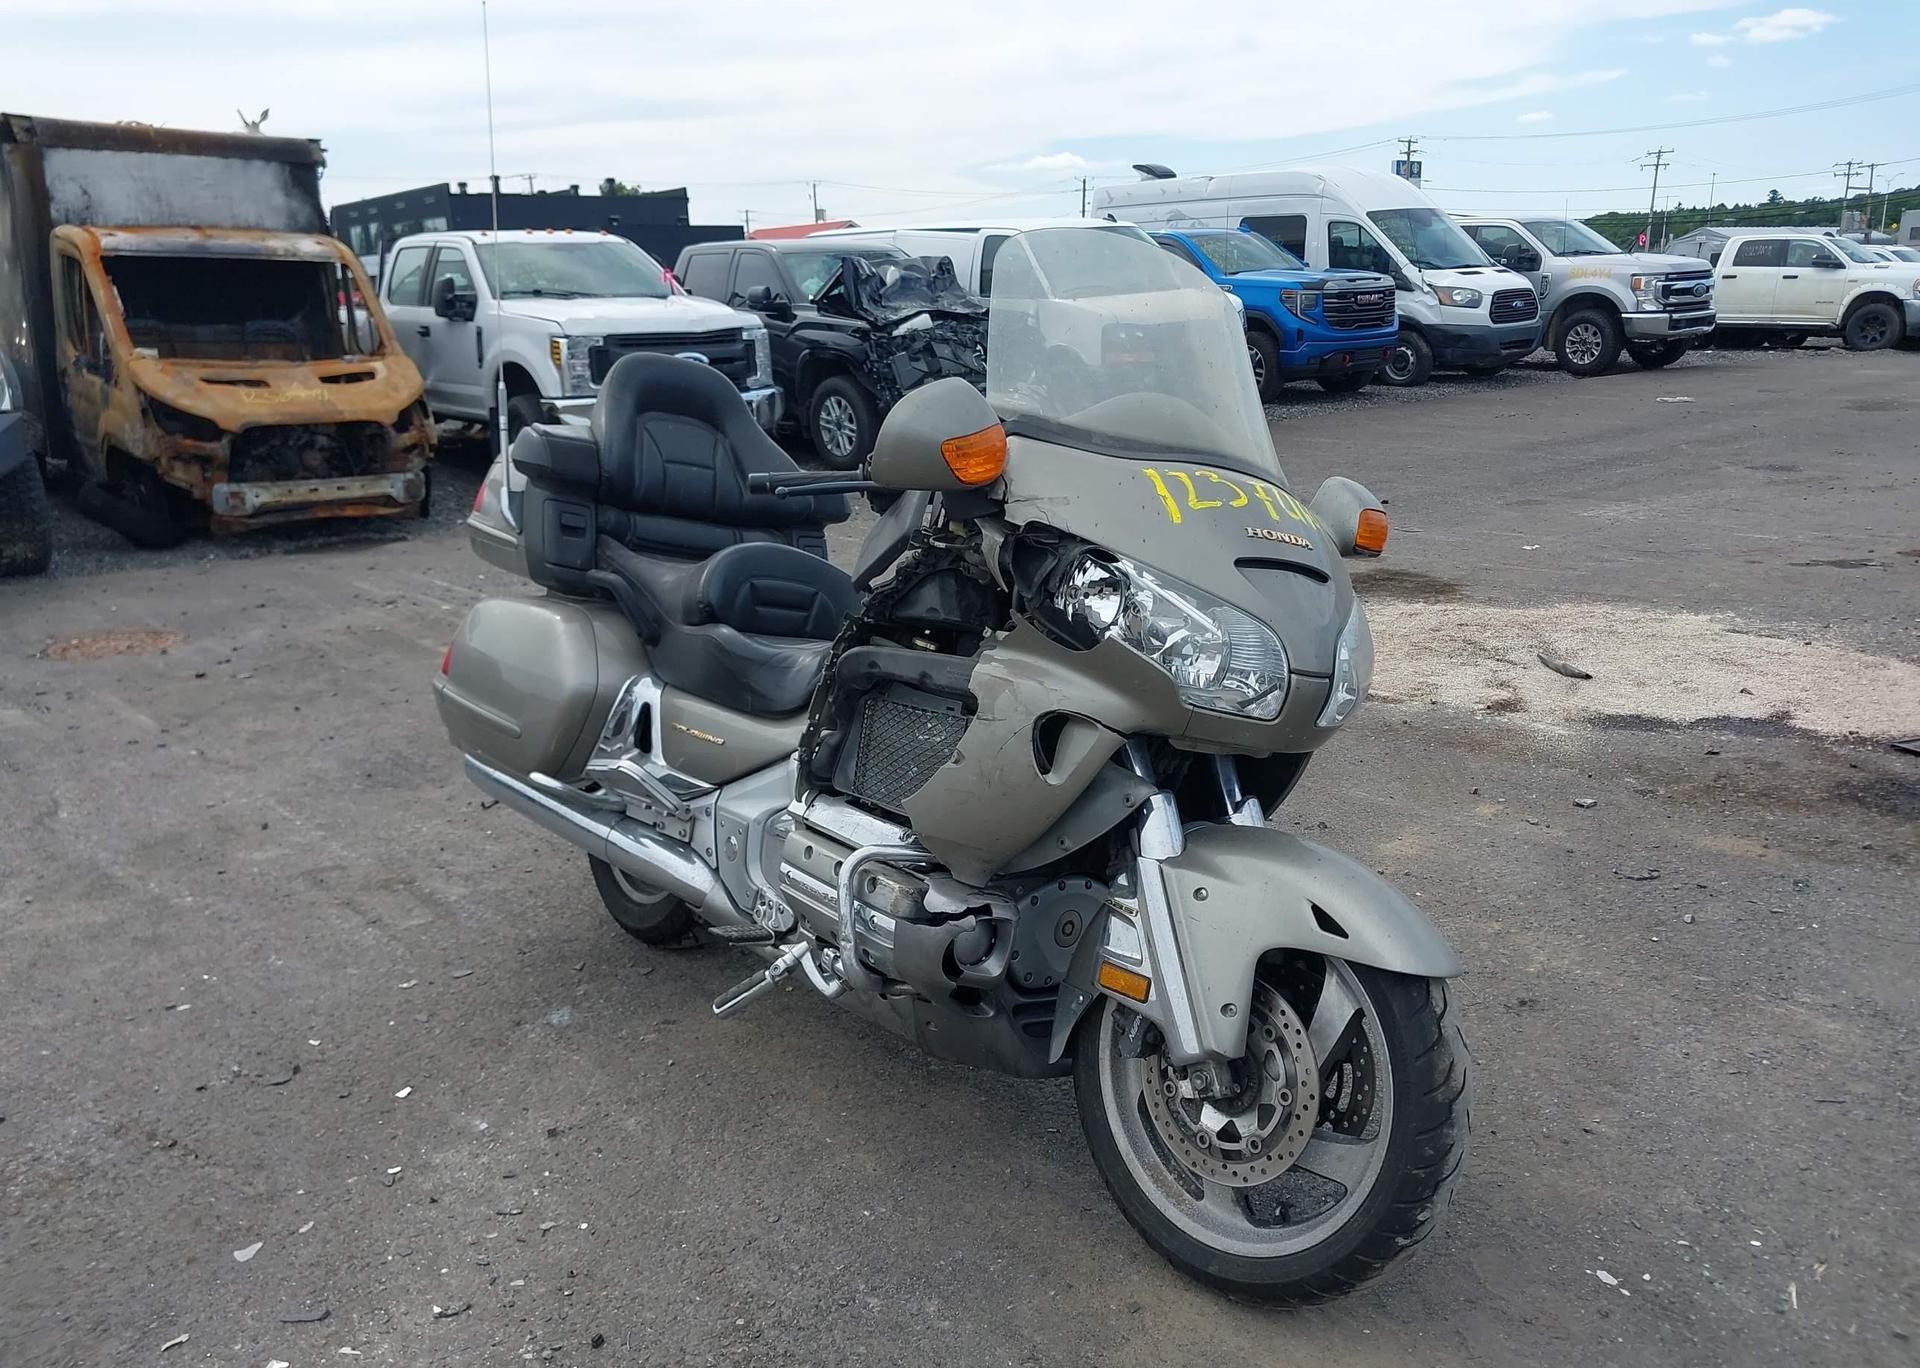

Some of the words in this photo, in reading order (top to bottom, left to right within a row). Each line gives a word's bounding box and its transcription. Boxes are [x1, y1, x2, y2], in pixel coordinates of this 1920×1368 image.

[1357, 294, 1384, 304] GMC
[1245, 527, 1314, 550] HONDA
[1105, 899, 1136, 915] ABS
